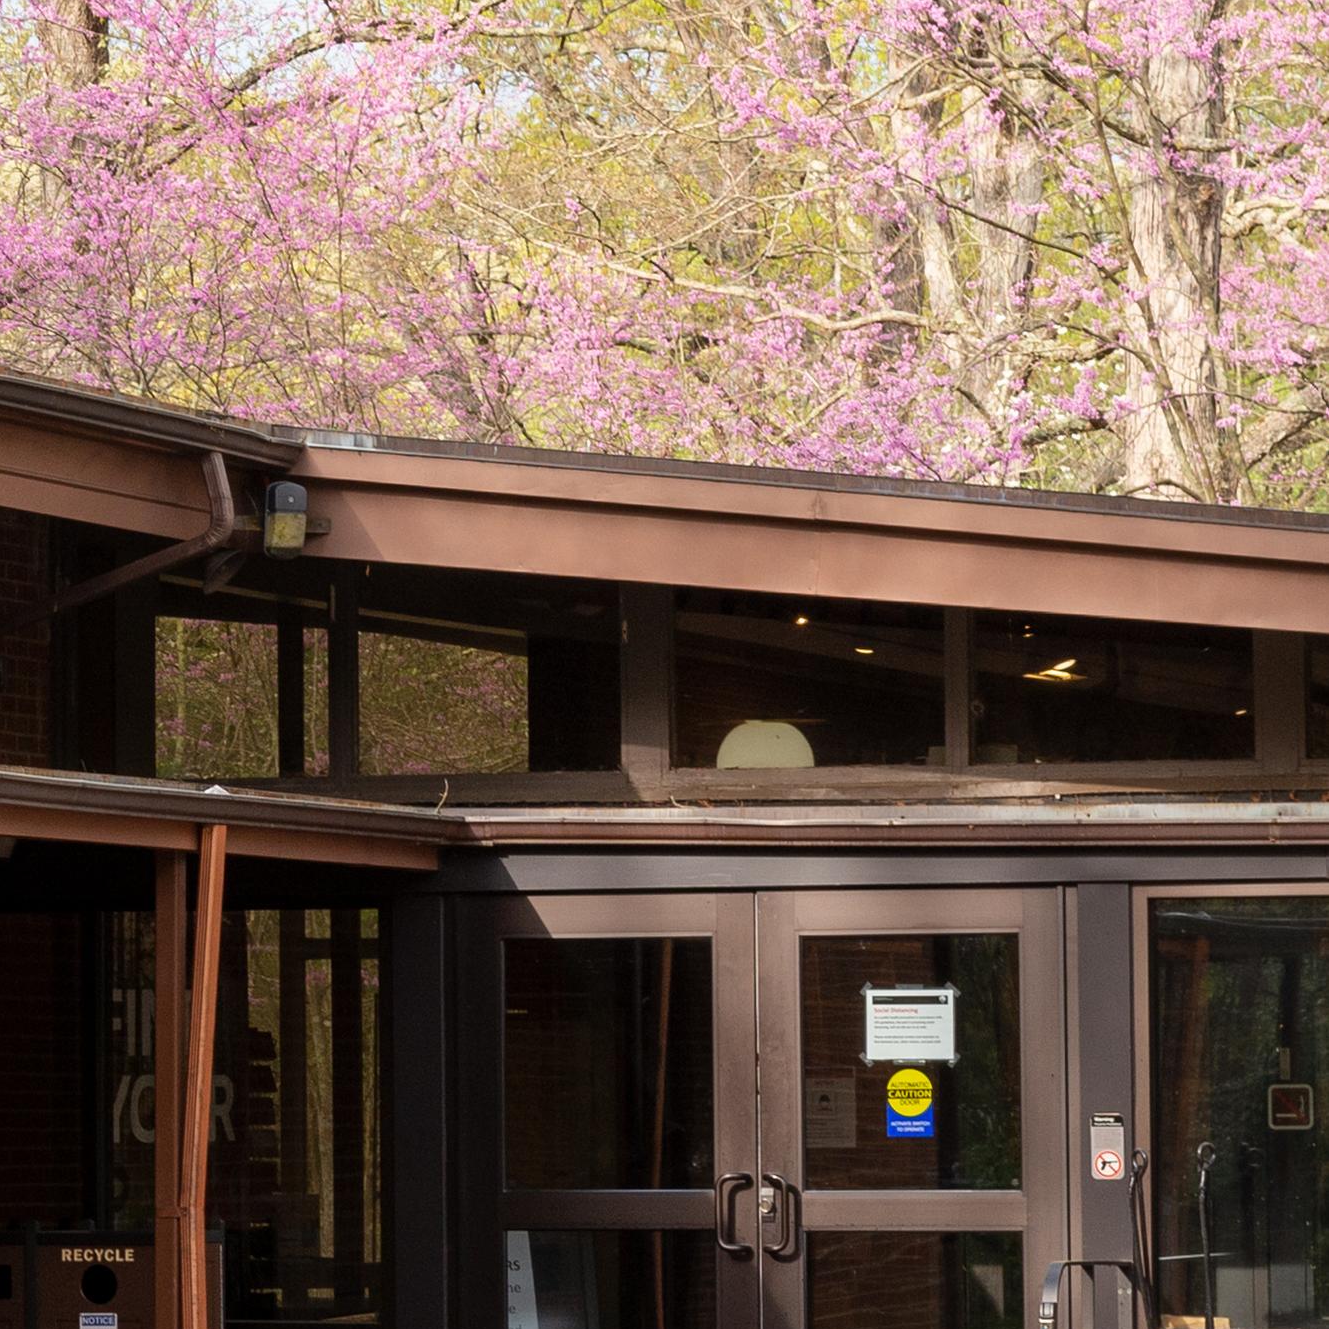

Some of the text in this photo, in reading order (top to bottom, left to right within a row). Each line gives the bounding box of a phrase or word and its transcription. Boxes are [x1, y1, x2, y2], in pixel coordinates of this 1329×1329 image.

[888, 1089, 932, 1099] CAUTION
[899, 1098, 920, 1106] DOOR
[61, 1248, 135, 1262] RECYCLE
[82, 1316, 114, 1325] NOTICE
